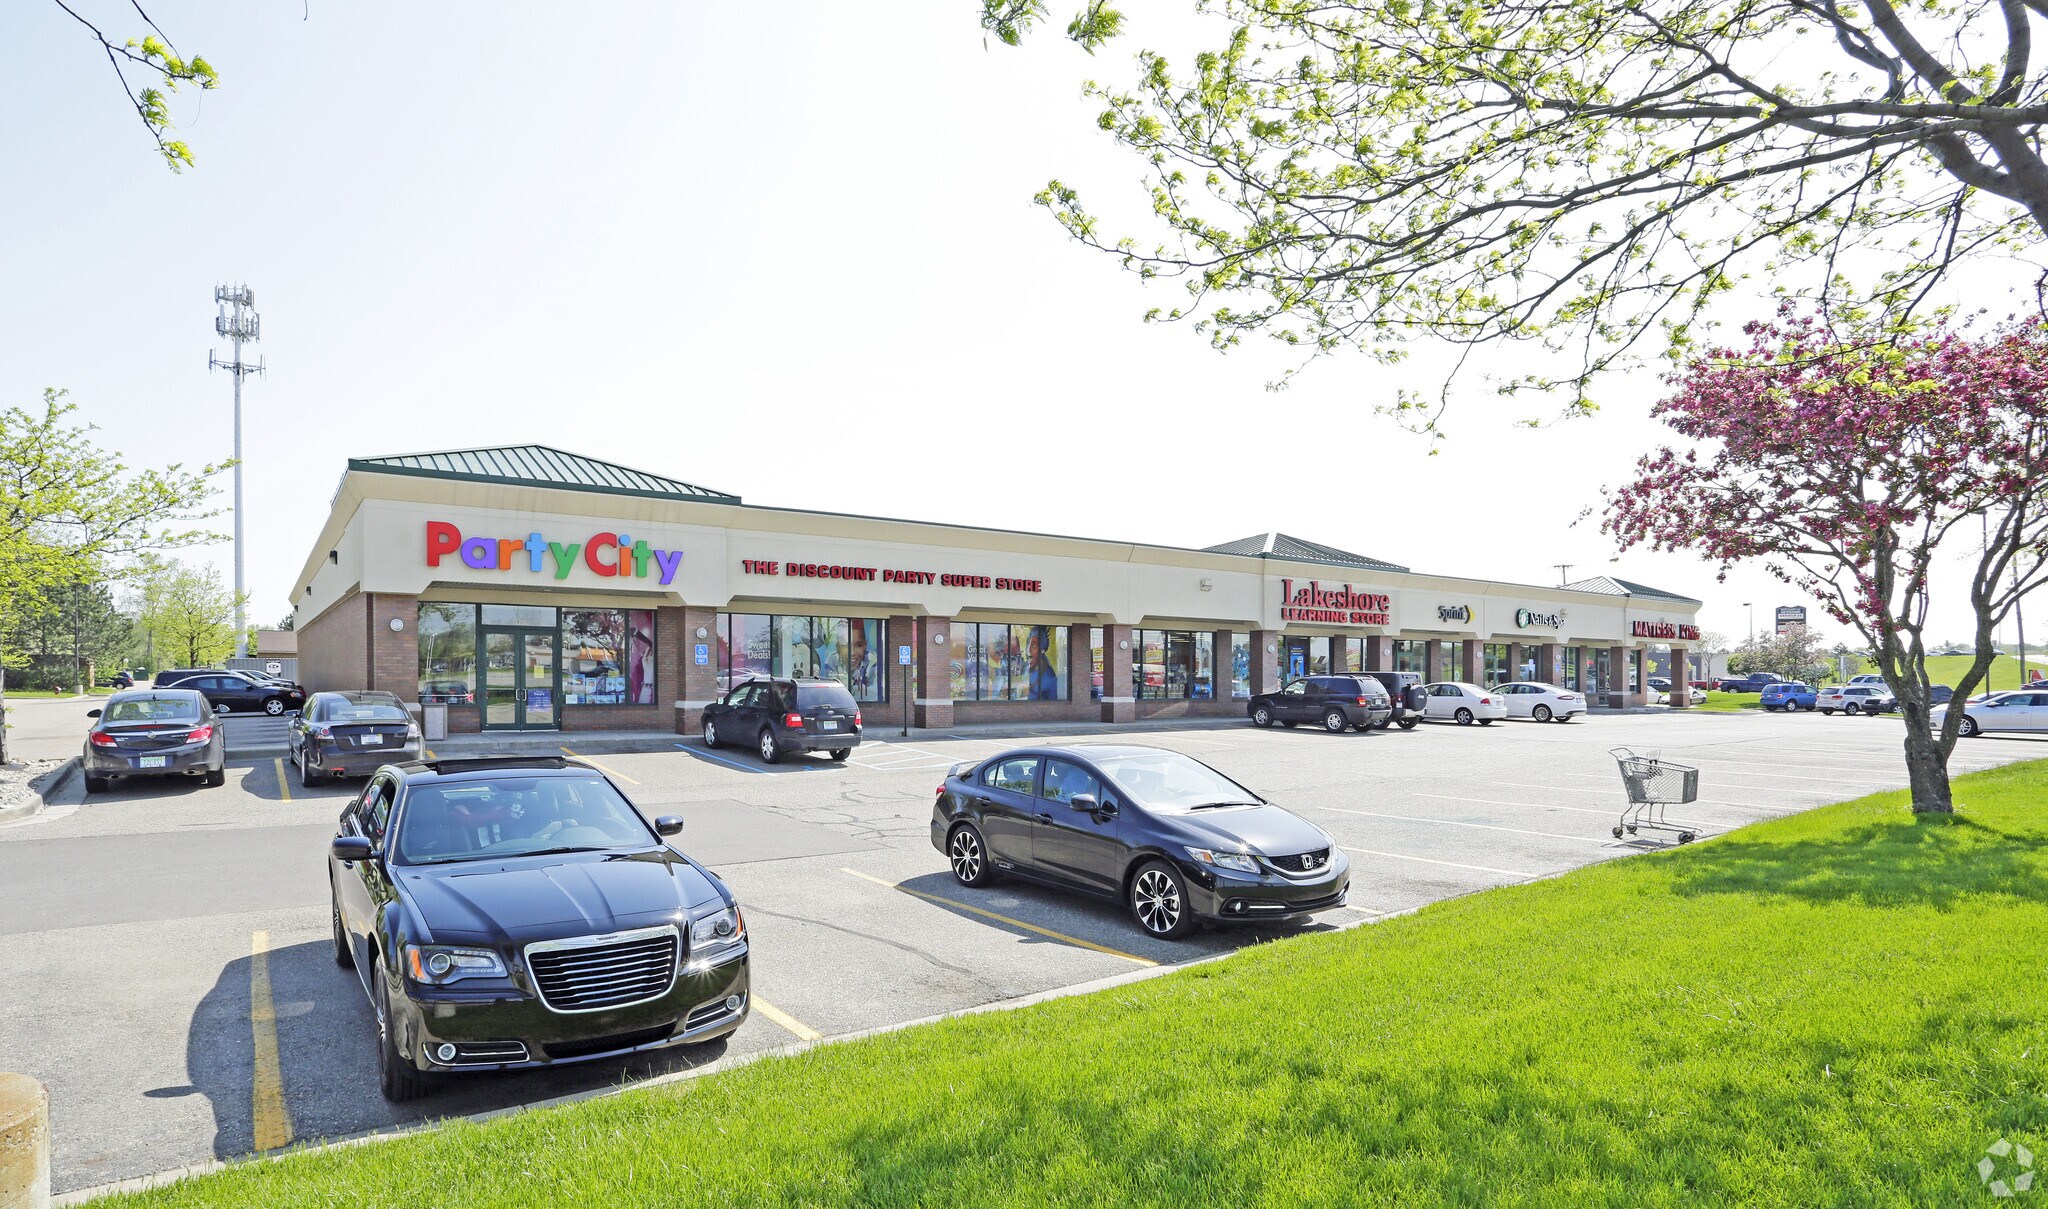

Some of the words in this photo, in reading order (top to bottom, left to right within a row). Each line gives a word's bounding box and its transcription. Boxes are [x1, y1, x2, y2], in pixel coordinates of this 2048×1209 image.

[427, 521, 581, 579] Party
[585, 532, 684, 584] City
[743, 560, 779, 575] THE
[786, 563, 878, 581] DISCOUNT
[883, 569, 936, 585] PARTY
[941, 574, 991, 589] SUPER
[996, 577, 1042, 592] STORE
[1281, 579, 1390, 612] Lakeshore
[1281, 608, 1348, 623] LEARNING
[1349, 612, 1390, 625] STORE
[1438, 605, 1465, 622] Sprint
[1633, 621, 1676, 639] MATTRESS
[1679, 624, 1700, 640] KING
[747, 650, 771, 659] Deals!
[967, 644, 986, 653] Grat
